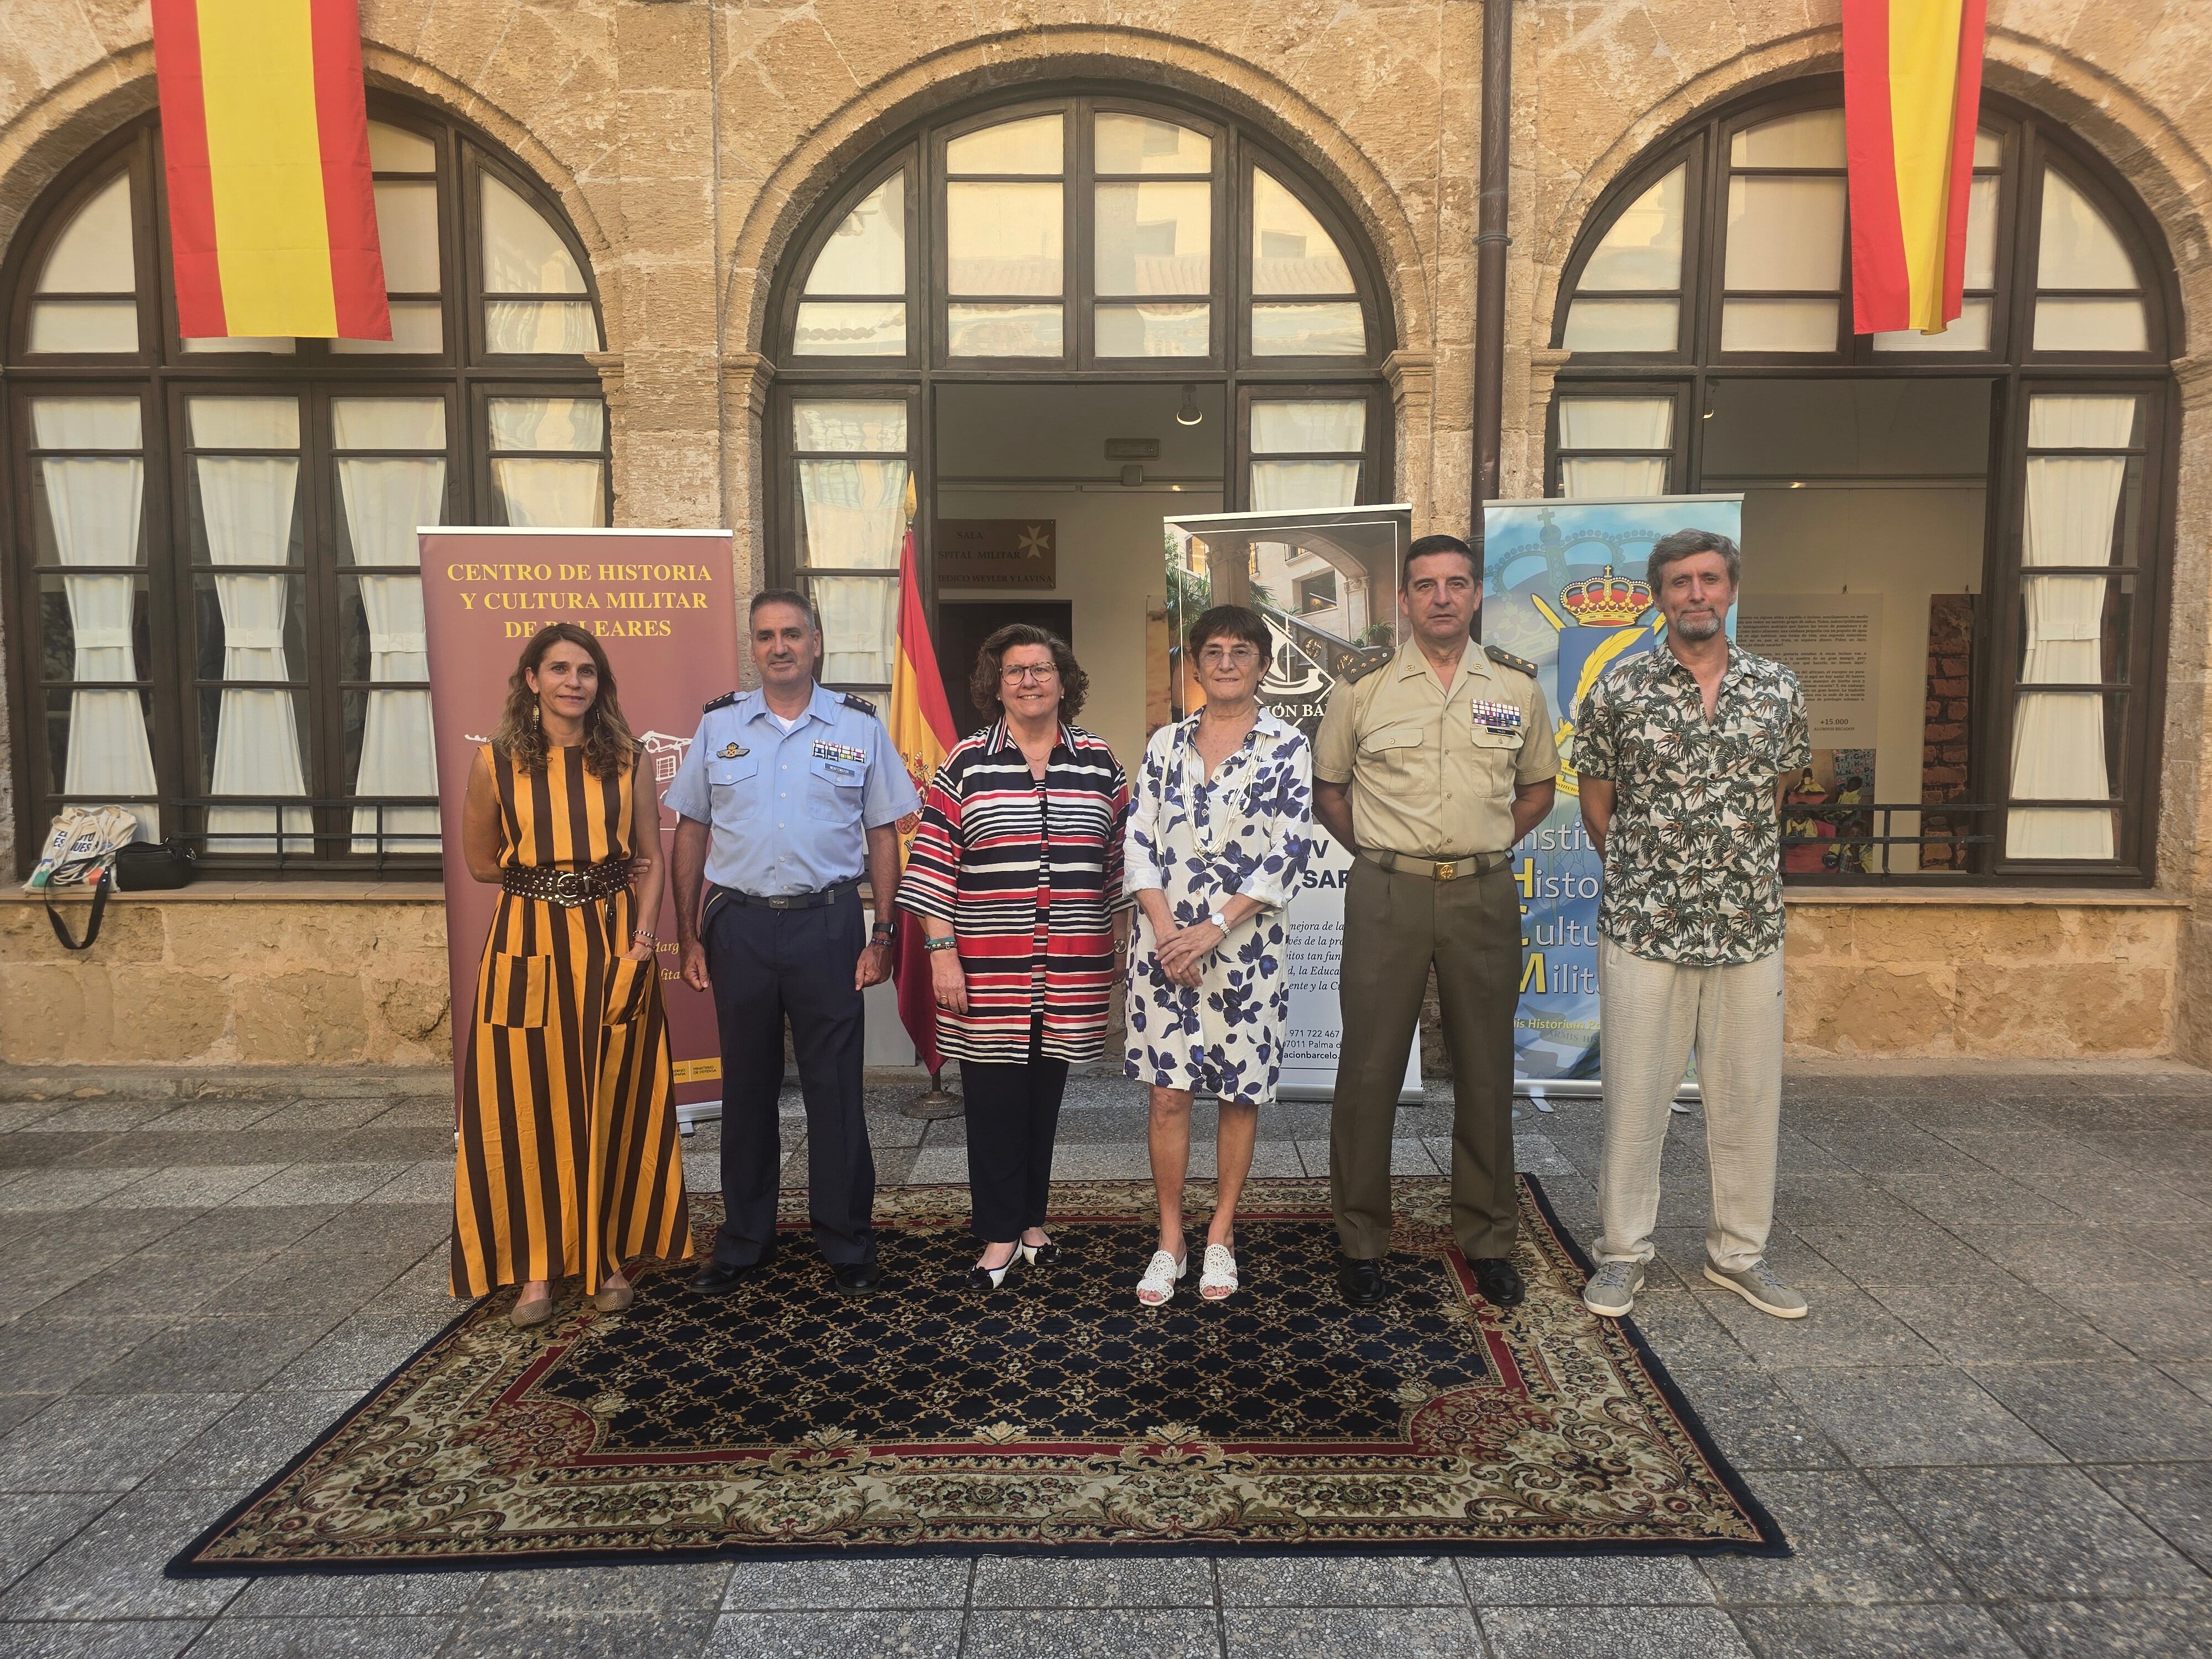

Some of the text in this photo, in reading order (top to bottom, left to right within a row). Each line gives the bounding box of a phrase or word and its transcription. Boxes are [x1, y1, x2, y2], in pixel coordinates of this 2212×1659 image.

[447, 564, 713, 581] CENTRO DE HISTORIA
[1018, 573, 1052, 582] LAVIÑA
[460, 592, 708, 610] Y CULTURA MILITAR
[504, 620, 538, 638] DE
[1302, 703, 1327, 716] BA
[1322, 921, 1333, 930] de
[1336, 921, 1344, 930] la
[1305, 936, 1315, 945] de
[1318, 936, 1327, 945] la
[1287, 951, 1305, 960] itos
[1323, 951, 1340, 962] fun
[1288, 966, 1339, 976] d, la Educa
[1310, 983, 1316, 992] y
[1319, 981, 1328, 990] la
[1528, 1019, 1585, 1029] Historium
[1284, 1051, 1339, 1059] acionbarcelo.
